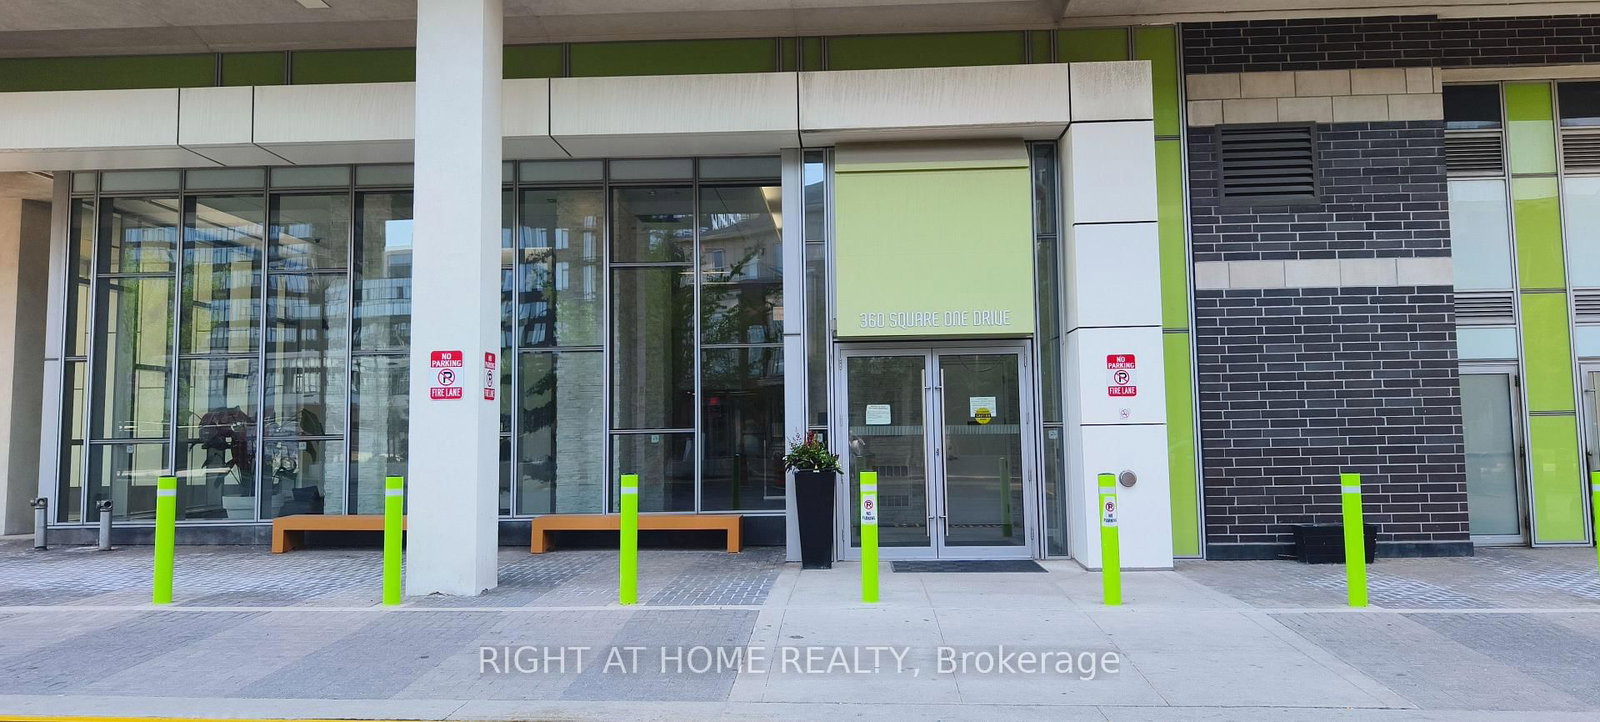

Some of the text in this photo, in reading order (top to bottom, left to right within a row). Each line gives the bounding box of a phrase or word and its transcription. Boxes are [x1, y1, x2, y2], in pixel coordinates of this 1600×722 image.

[859, 309, 1010, 330] 360 SQUARE ONE DRIVE
[431, 388, 461, 397] FIRE LANE
[1109, 386, 1135, 395] FIRE LANE
